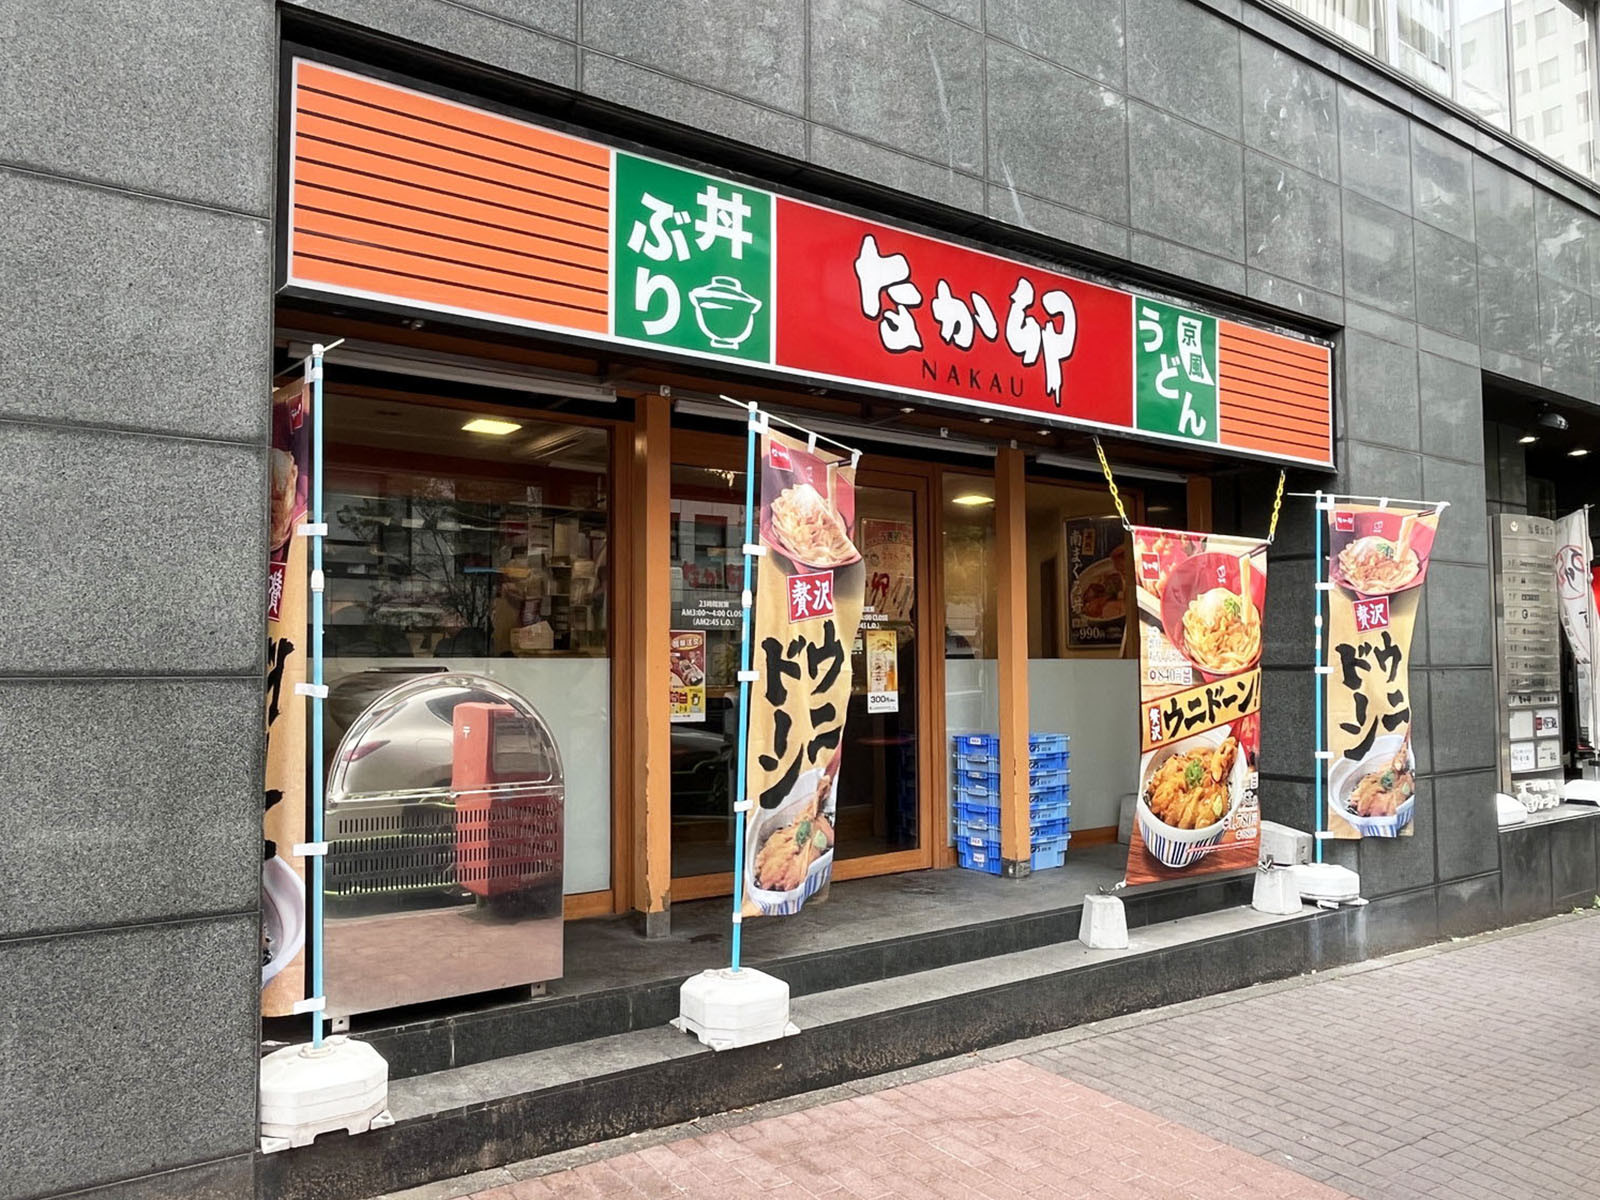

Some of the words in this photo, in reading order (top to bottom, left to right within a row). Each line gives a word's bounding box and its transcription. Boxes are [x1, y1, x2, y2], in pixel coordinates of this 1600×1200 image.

[695, 185, 752, 260] 丼
[627, 192, 692, 335] ぶり
[854, 234, 1078, 407] なか卯
[1182, 321, 1204, 379] 京風
[922, 359, 1024, 397] NAKAU
[1139, 306, 1206, 436] うどん
[791, 579, 833, 617] 贅沢
[1356, 602, 1387, 630] 贅沢
